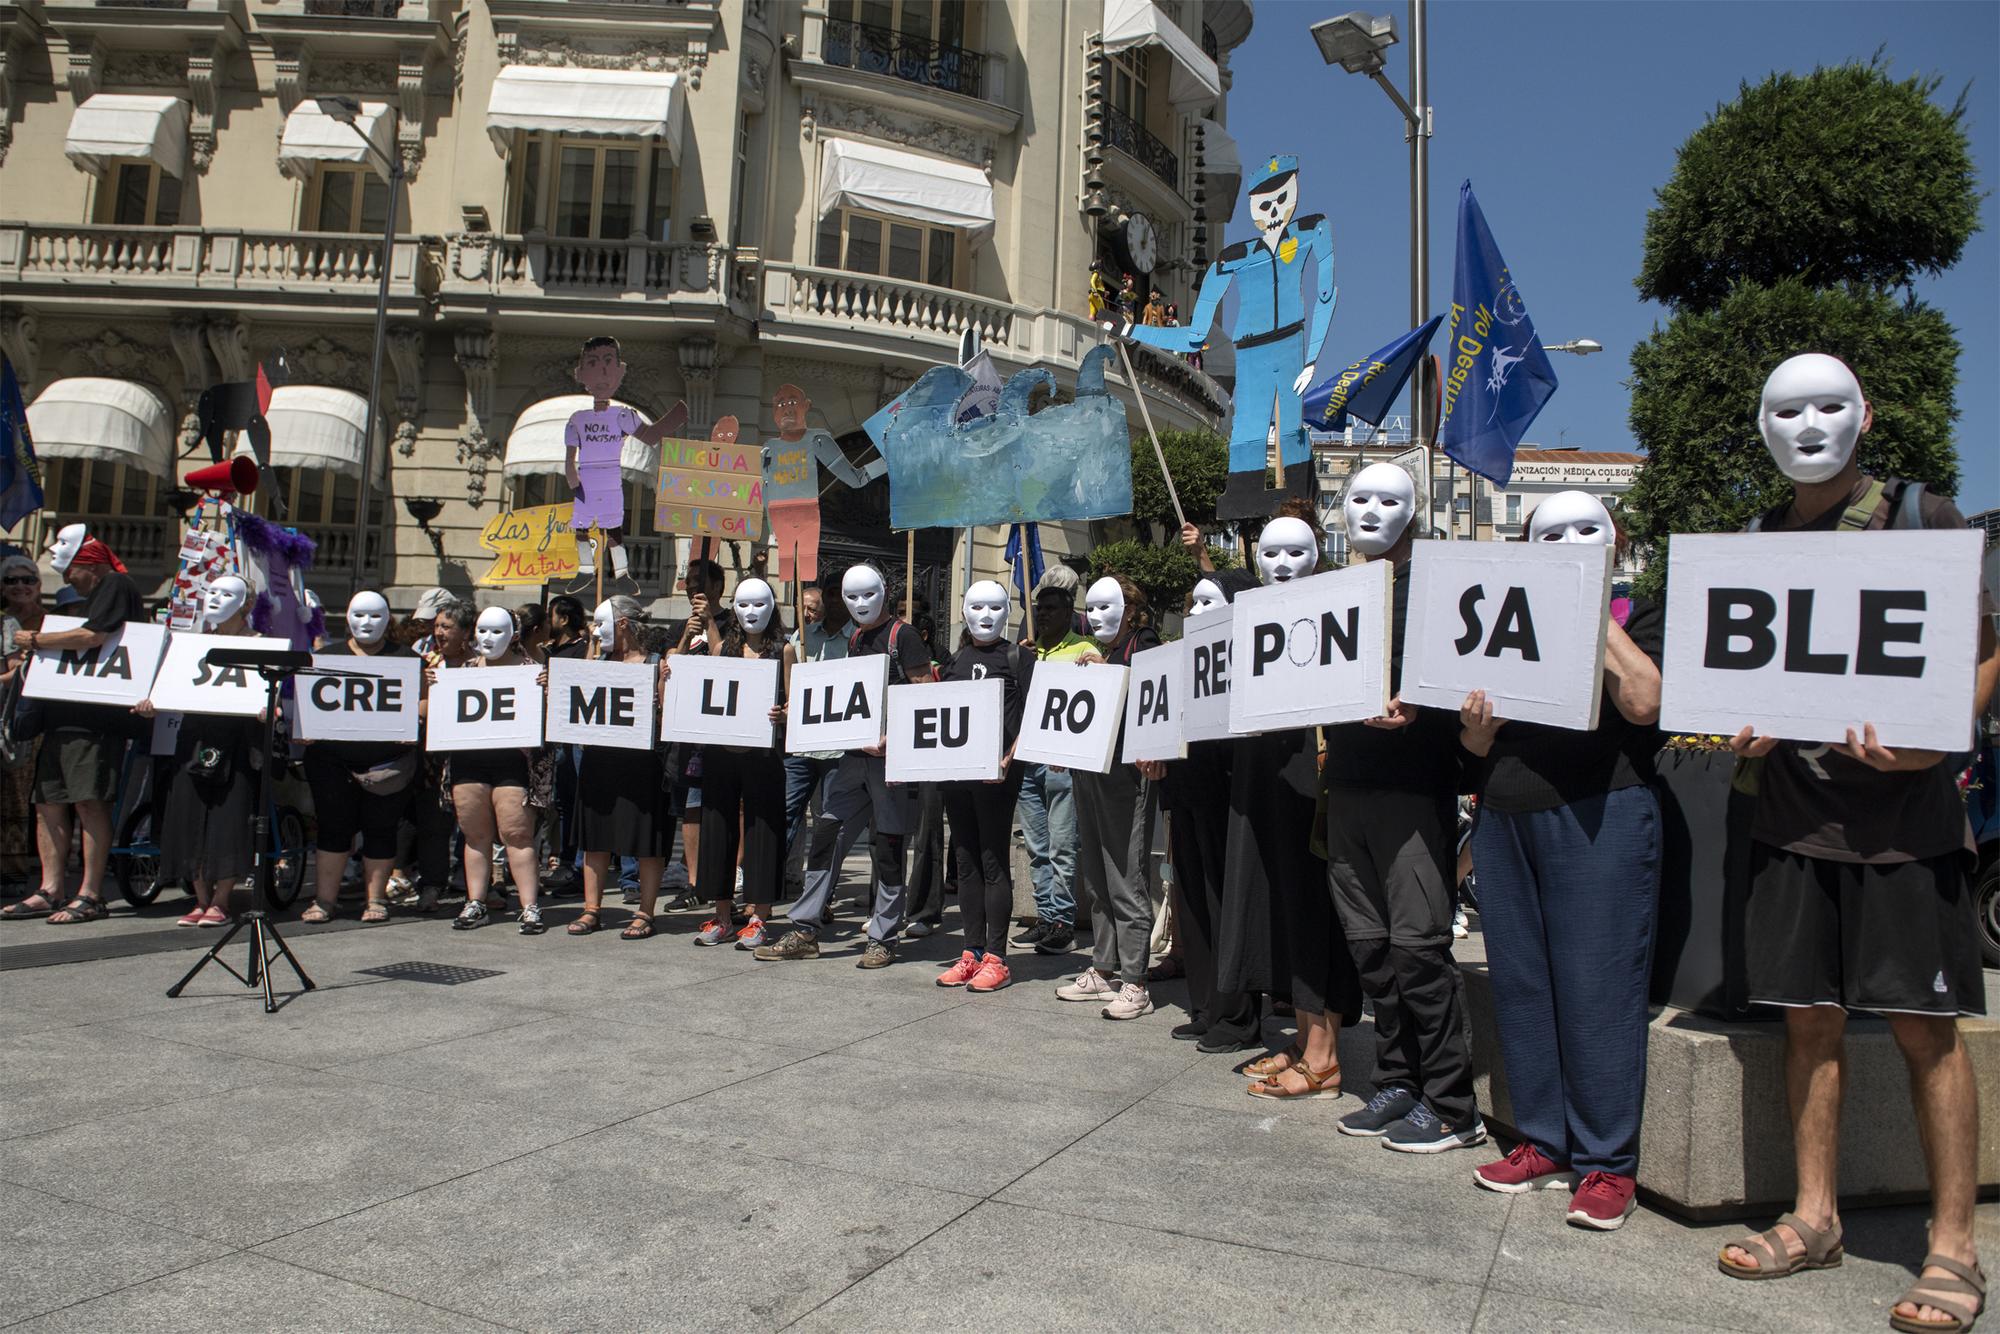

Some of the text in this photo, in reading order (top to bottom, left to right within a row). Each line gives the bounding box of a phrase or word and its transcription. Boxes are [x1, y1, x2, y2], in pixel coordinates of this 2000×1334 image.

[584, 423, 599, 433] NO
[661, 471, 762, 505] PERSONA
[1563, 467, 1596, 476] MÉDICA
[487, 511, 530, 542] Las
[502, 551, 575, 577] Matan
[1454, 583, 1541, 662] SA
[1703, 587, 1927, 679] BLE
[1253, 606, 1360, 677] PON
[56, 645, 132, 680] MA
[192, 656, 248, 688] SA
[311, 676, 402, 713] CRE
[457, 687, 515, 722] DE
[569, 685, 635, 727] ME
[701, 678, 739, 716] LI
[802, 681, 871, 725] LLA
[1041, 688, 1096, 734] RO
[1137, 674, 1169, 727] PA
[913, 706, 970, 749] EU
